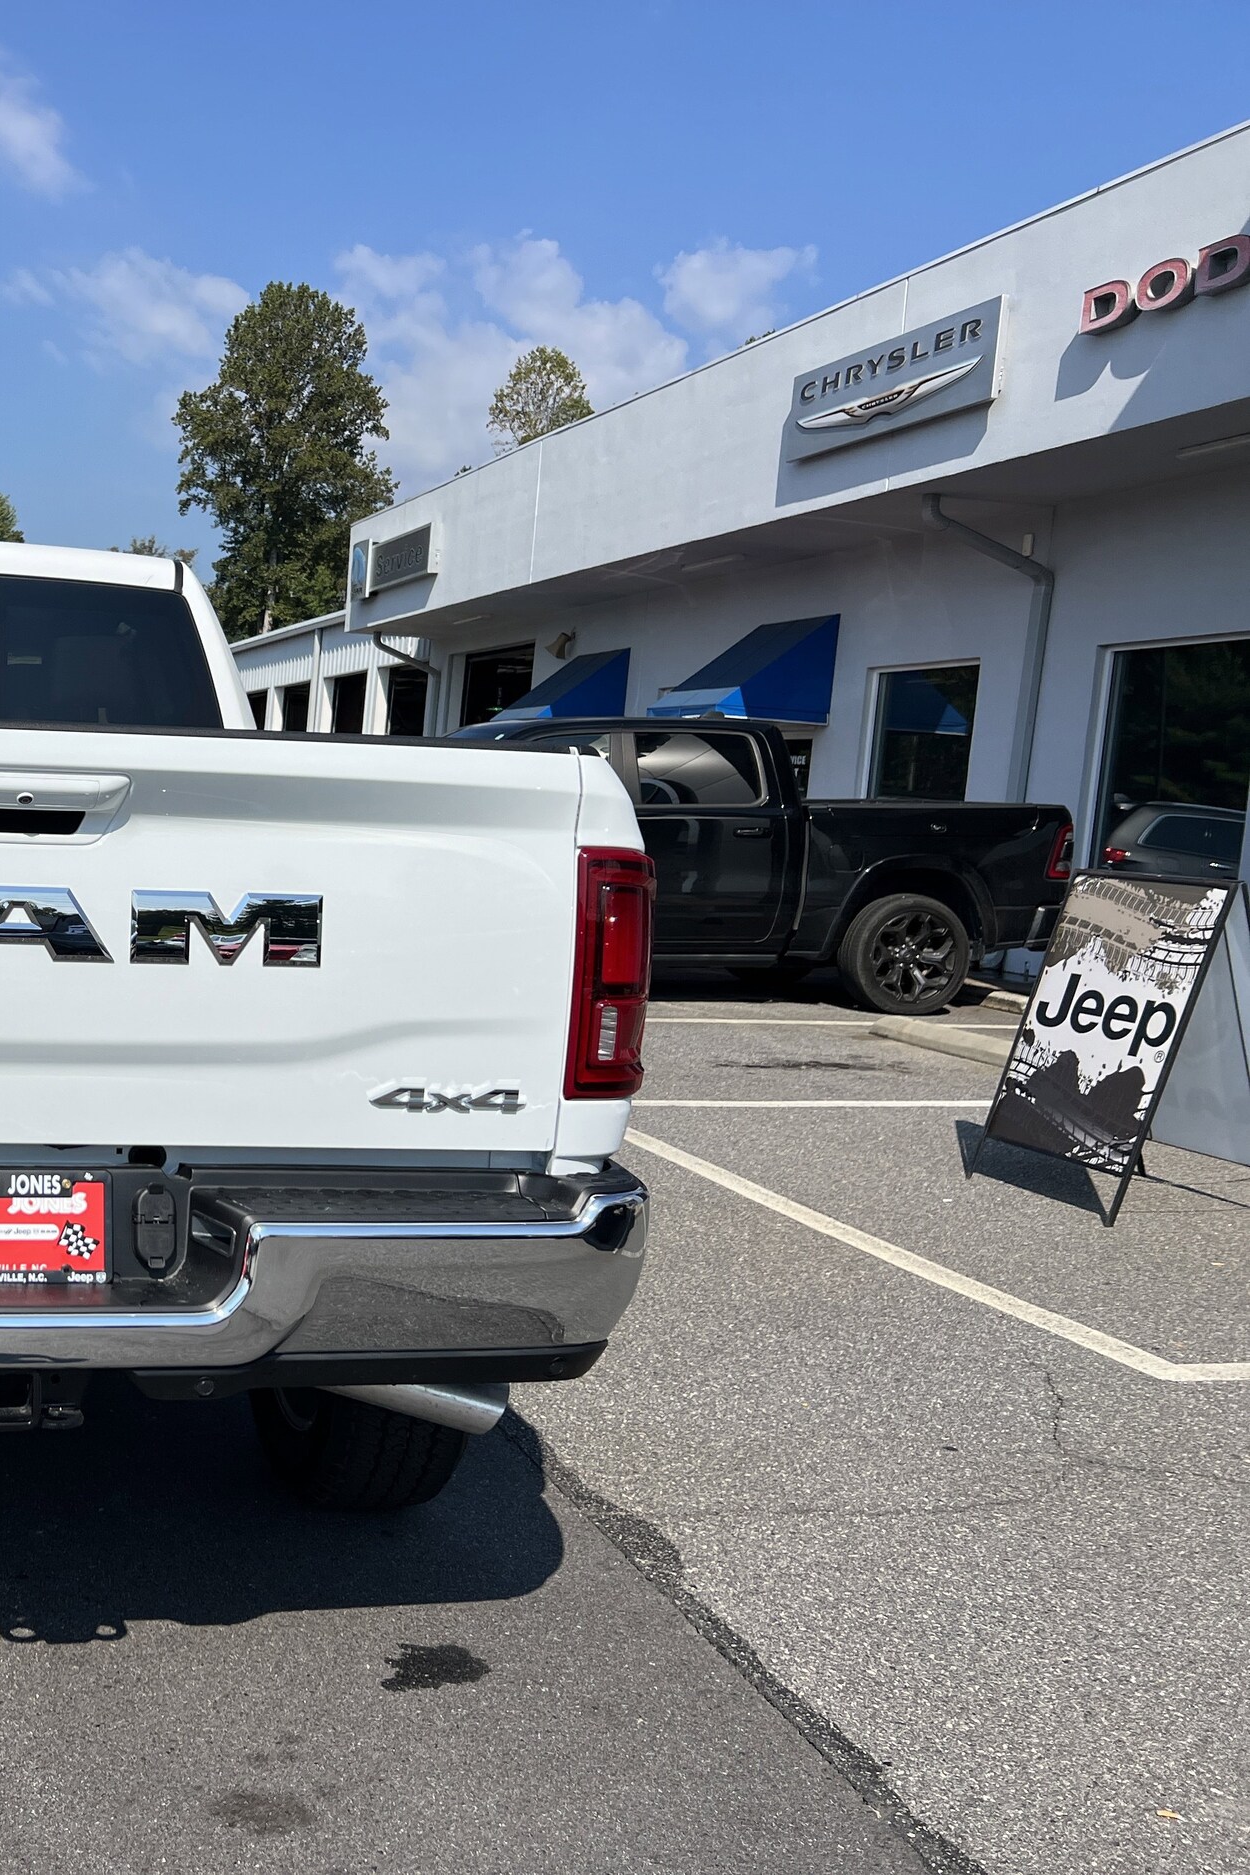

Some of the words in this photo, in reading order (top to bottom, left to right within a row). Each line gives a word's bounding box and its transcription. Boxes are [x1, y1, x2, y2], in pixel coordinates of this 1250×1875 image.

[799, 318, 983, 403] CHRYSLER
[861, 393, 898, 409] CHRYSLER
[376, 545, 423, 577] Service
[1035, 973, 1177, 1057] Jeep
[368, 1084, 527, 1115] 4x4
[7, 1174, 61, 1195] JONES
[7, 1192, 87, 1215] JONES
[13, 1227, 31, 1236] Jeep
[28, 1273, 48, 1283] N.C.
[67, 1272, 94, 1284] Jeep
